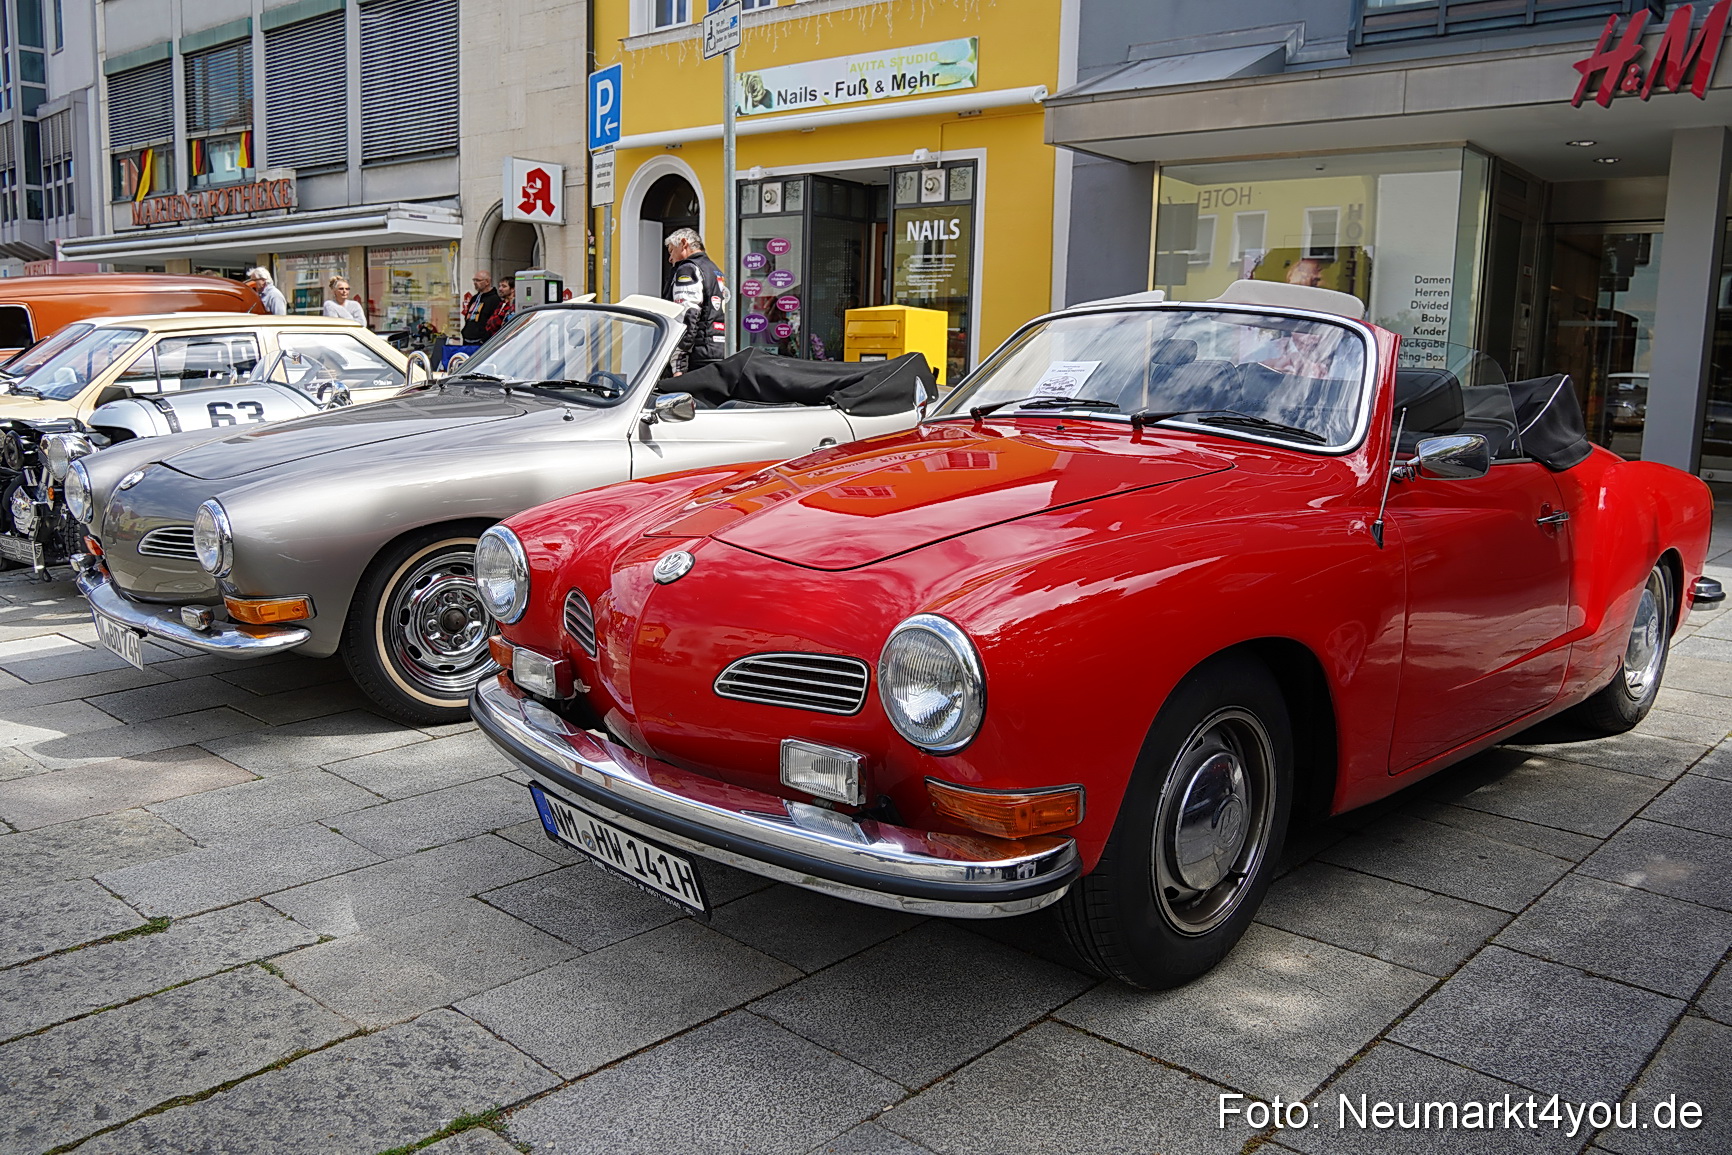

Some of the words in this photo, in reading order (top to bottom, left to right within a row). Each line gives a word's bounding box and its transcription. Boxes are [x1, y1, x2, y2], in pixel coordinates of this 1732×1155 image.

[850, 60, 885, 73] AVITA
[889, 51, 939, 68] STUDIO
[1571, 0, 1731, 108] H&M
[777, 88, 818, 106] Nails
[834, 79, 869, 98] Fuß
[874, 81, 885, 93] &
[891, 70, 940, 92] Mehr
[595, 79, 614, 138] P
[131, 178, 292, 226] MARIEN-APOTHEKE
[906, 218, 960, 241] NAILS
[1415, 275, 1451, 284] Damen
[1415, 288, 1450, 297] Herren
[1411, 300, 1449, 310] Divided
[1422, 313, 1447, 325] Baby
[1413, 326, 1446, 335] Kinder
[1398, 352, 1444, 363] cling-Box
[206, 401, 266, 428] 63
[545, 798, 582, 845] NM
[588, 819, 627, 868] HW
[626, 839, 701, 904] 141H
